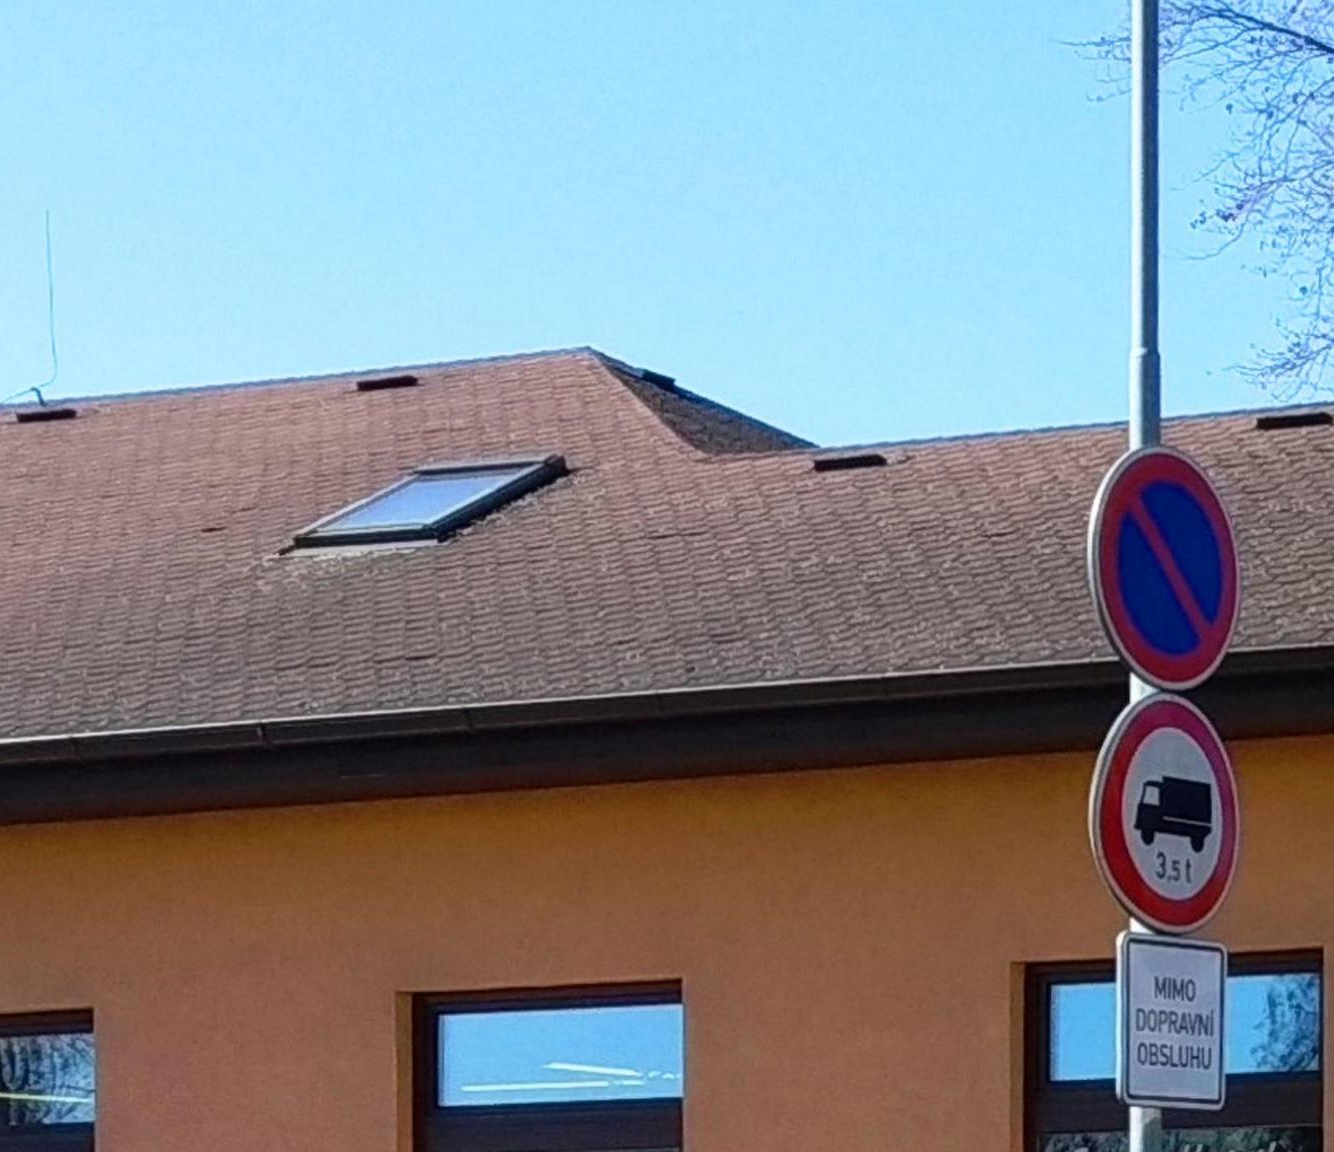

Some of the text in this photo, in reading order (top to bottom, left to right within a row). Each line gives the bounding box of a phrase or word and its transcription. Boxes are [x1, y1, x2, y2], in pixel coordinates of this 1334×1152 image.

[1185, 858, 1192, 883] t
[1154, 976, 1196, 1002] MIMO
[1135, 1007, 1214, 1037] DOPRAVNÍ
[1137, 1041, 1212, 1070] OBSLUHU
